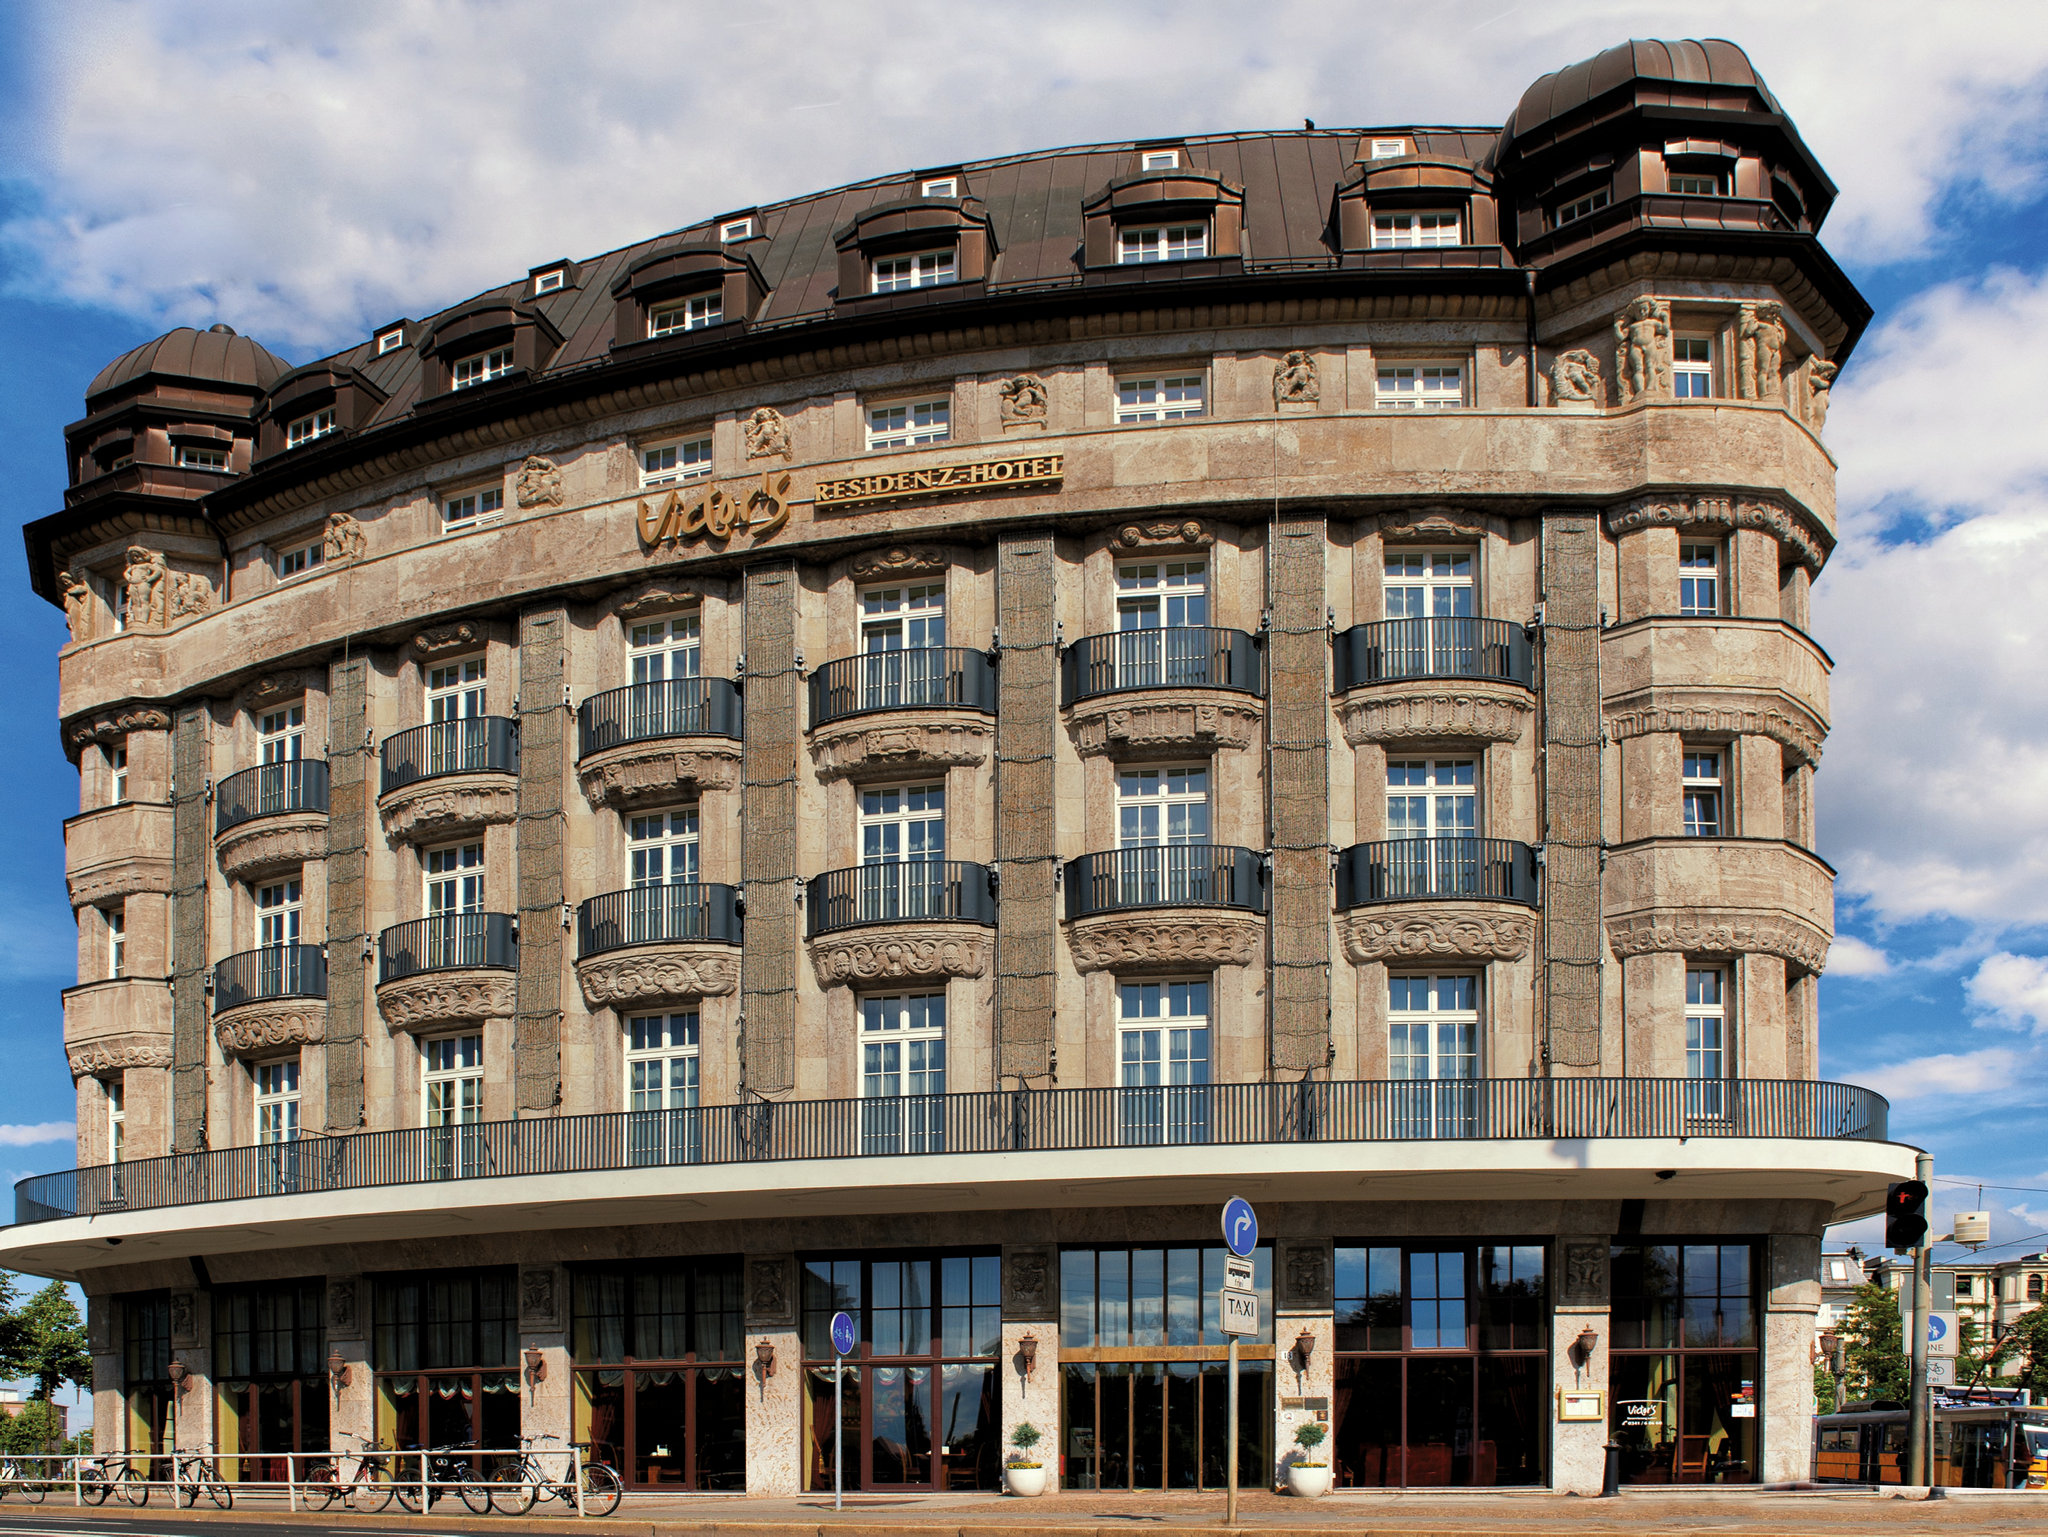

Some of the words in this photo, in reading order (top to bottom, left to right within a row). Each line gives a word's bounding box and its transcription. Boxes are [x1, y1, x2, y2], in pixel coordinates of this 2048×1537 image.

[815, 457, 1064, 501] RESIDENZ-HOTEL
[637, 470, 791, 546] Victor's
[1228, 1298, 1254, 1317] TAXI
